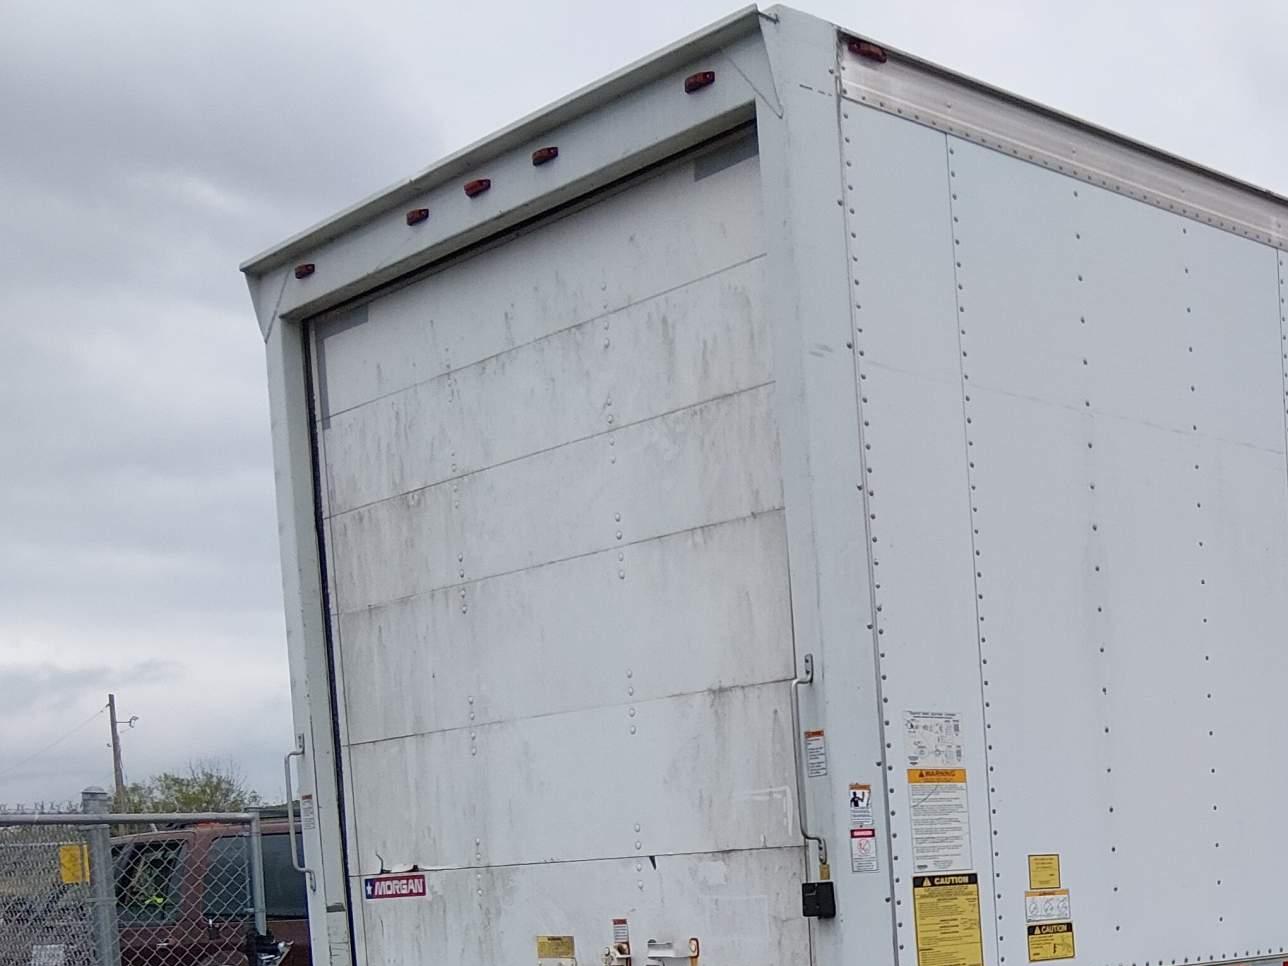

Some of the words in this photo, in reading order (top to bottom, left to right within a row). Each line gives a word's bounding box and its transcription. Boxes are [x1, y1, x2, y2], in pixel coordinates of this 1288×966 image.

[934, 876, 969, 885] CAUTION
[374, 879, 423, 895] MORGAN
[1041, 924, 1067, 933] CAUTION
